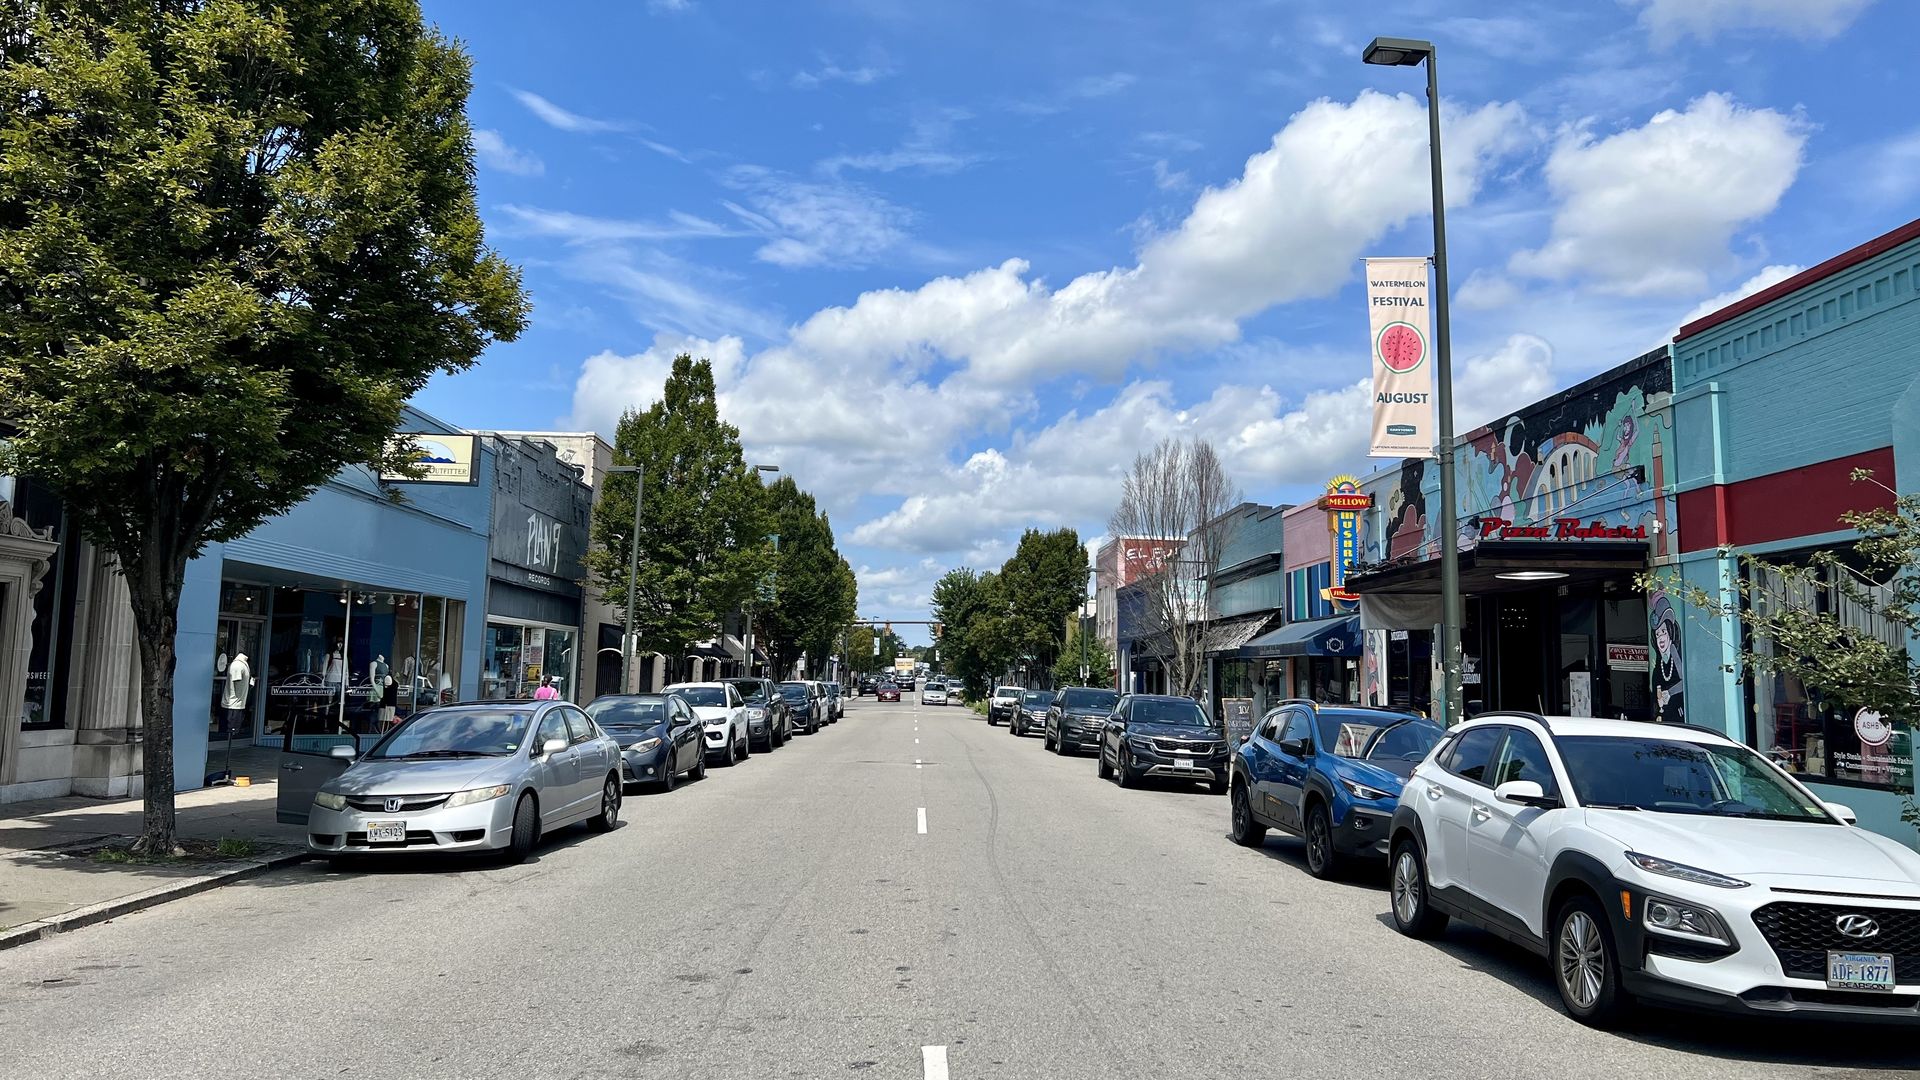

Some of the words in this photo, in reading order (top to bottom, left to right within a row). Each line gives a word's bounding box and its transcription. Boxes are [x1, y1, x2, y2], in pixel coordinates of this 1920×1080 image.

[1370, 280, 1426, 288] WATERMELON
[1372, 296, 1425, 307] FESTIVAL
[1376, 391, 1429, 404] AUGUST
[1329, 498, 1368, 506] MELLOW
[1479, 517, 1551, 538] Pizza
[1554, 518, 1650, 539] Bakers
[526, 513, 553, 567] PLAN
[553, 523, 562, 574] 9
[528, 573, 551, 586] RECORDS
[1833, 752, 1846, 762] Style
[1845, 762, 1881, 773] Contemporary
[1844, 954, 1876, 962] VIRGINIA
[1832, 963, 1889, 982] ADF-1877
[1838, 982, 1886, 990] PEARSON
